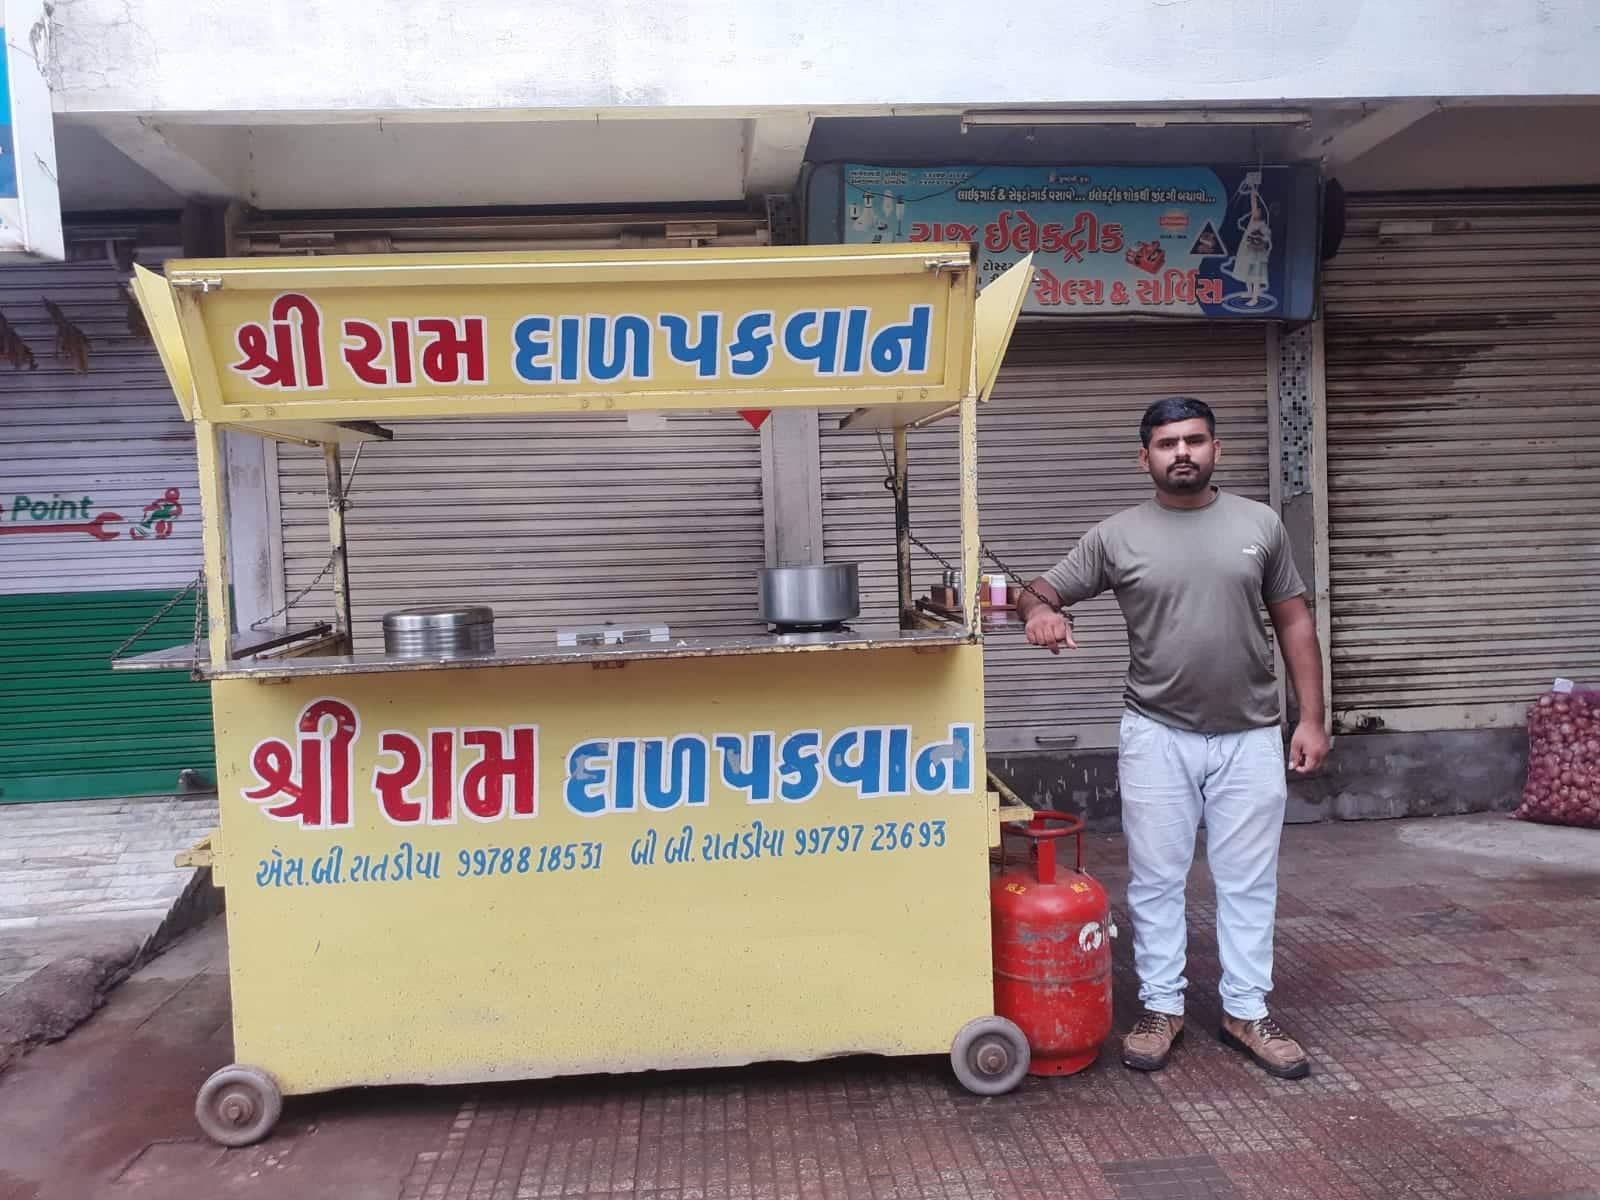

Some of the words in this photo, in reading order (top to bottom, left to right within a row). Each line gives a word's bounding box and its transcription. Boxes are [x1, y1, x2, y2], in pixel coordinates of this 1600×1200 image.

[997, 188, 1006, 201] &
[1034, 268, 1105, 305] સેલ્સ
[1109, 281, 1130, 305] &
[1134, 268, 1224, 305] સર્વિસ
[231, 291, 328, 391] શ્રી
[341, 315, 489, 389] રામ
[11, 493, 94, 522] Point
[241, 696, 361, 831] શ્રી
[370, 723, 539, 826] રામ
